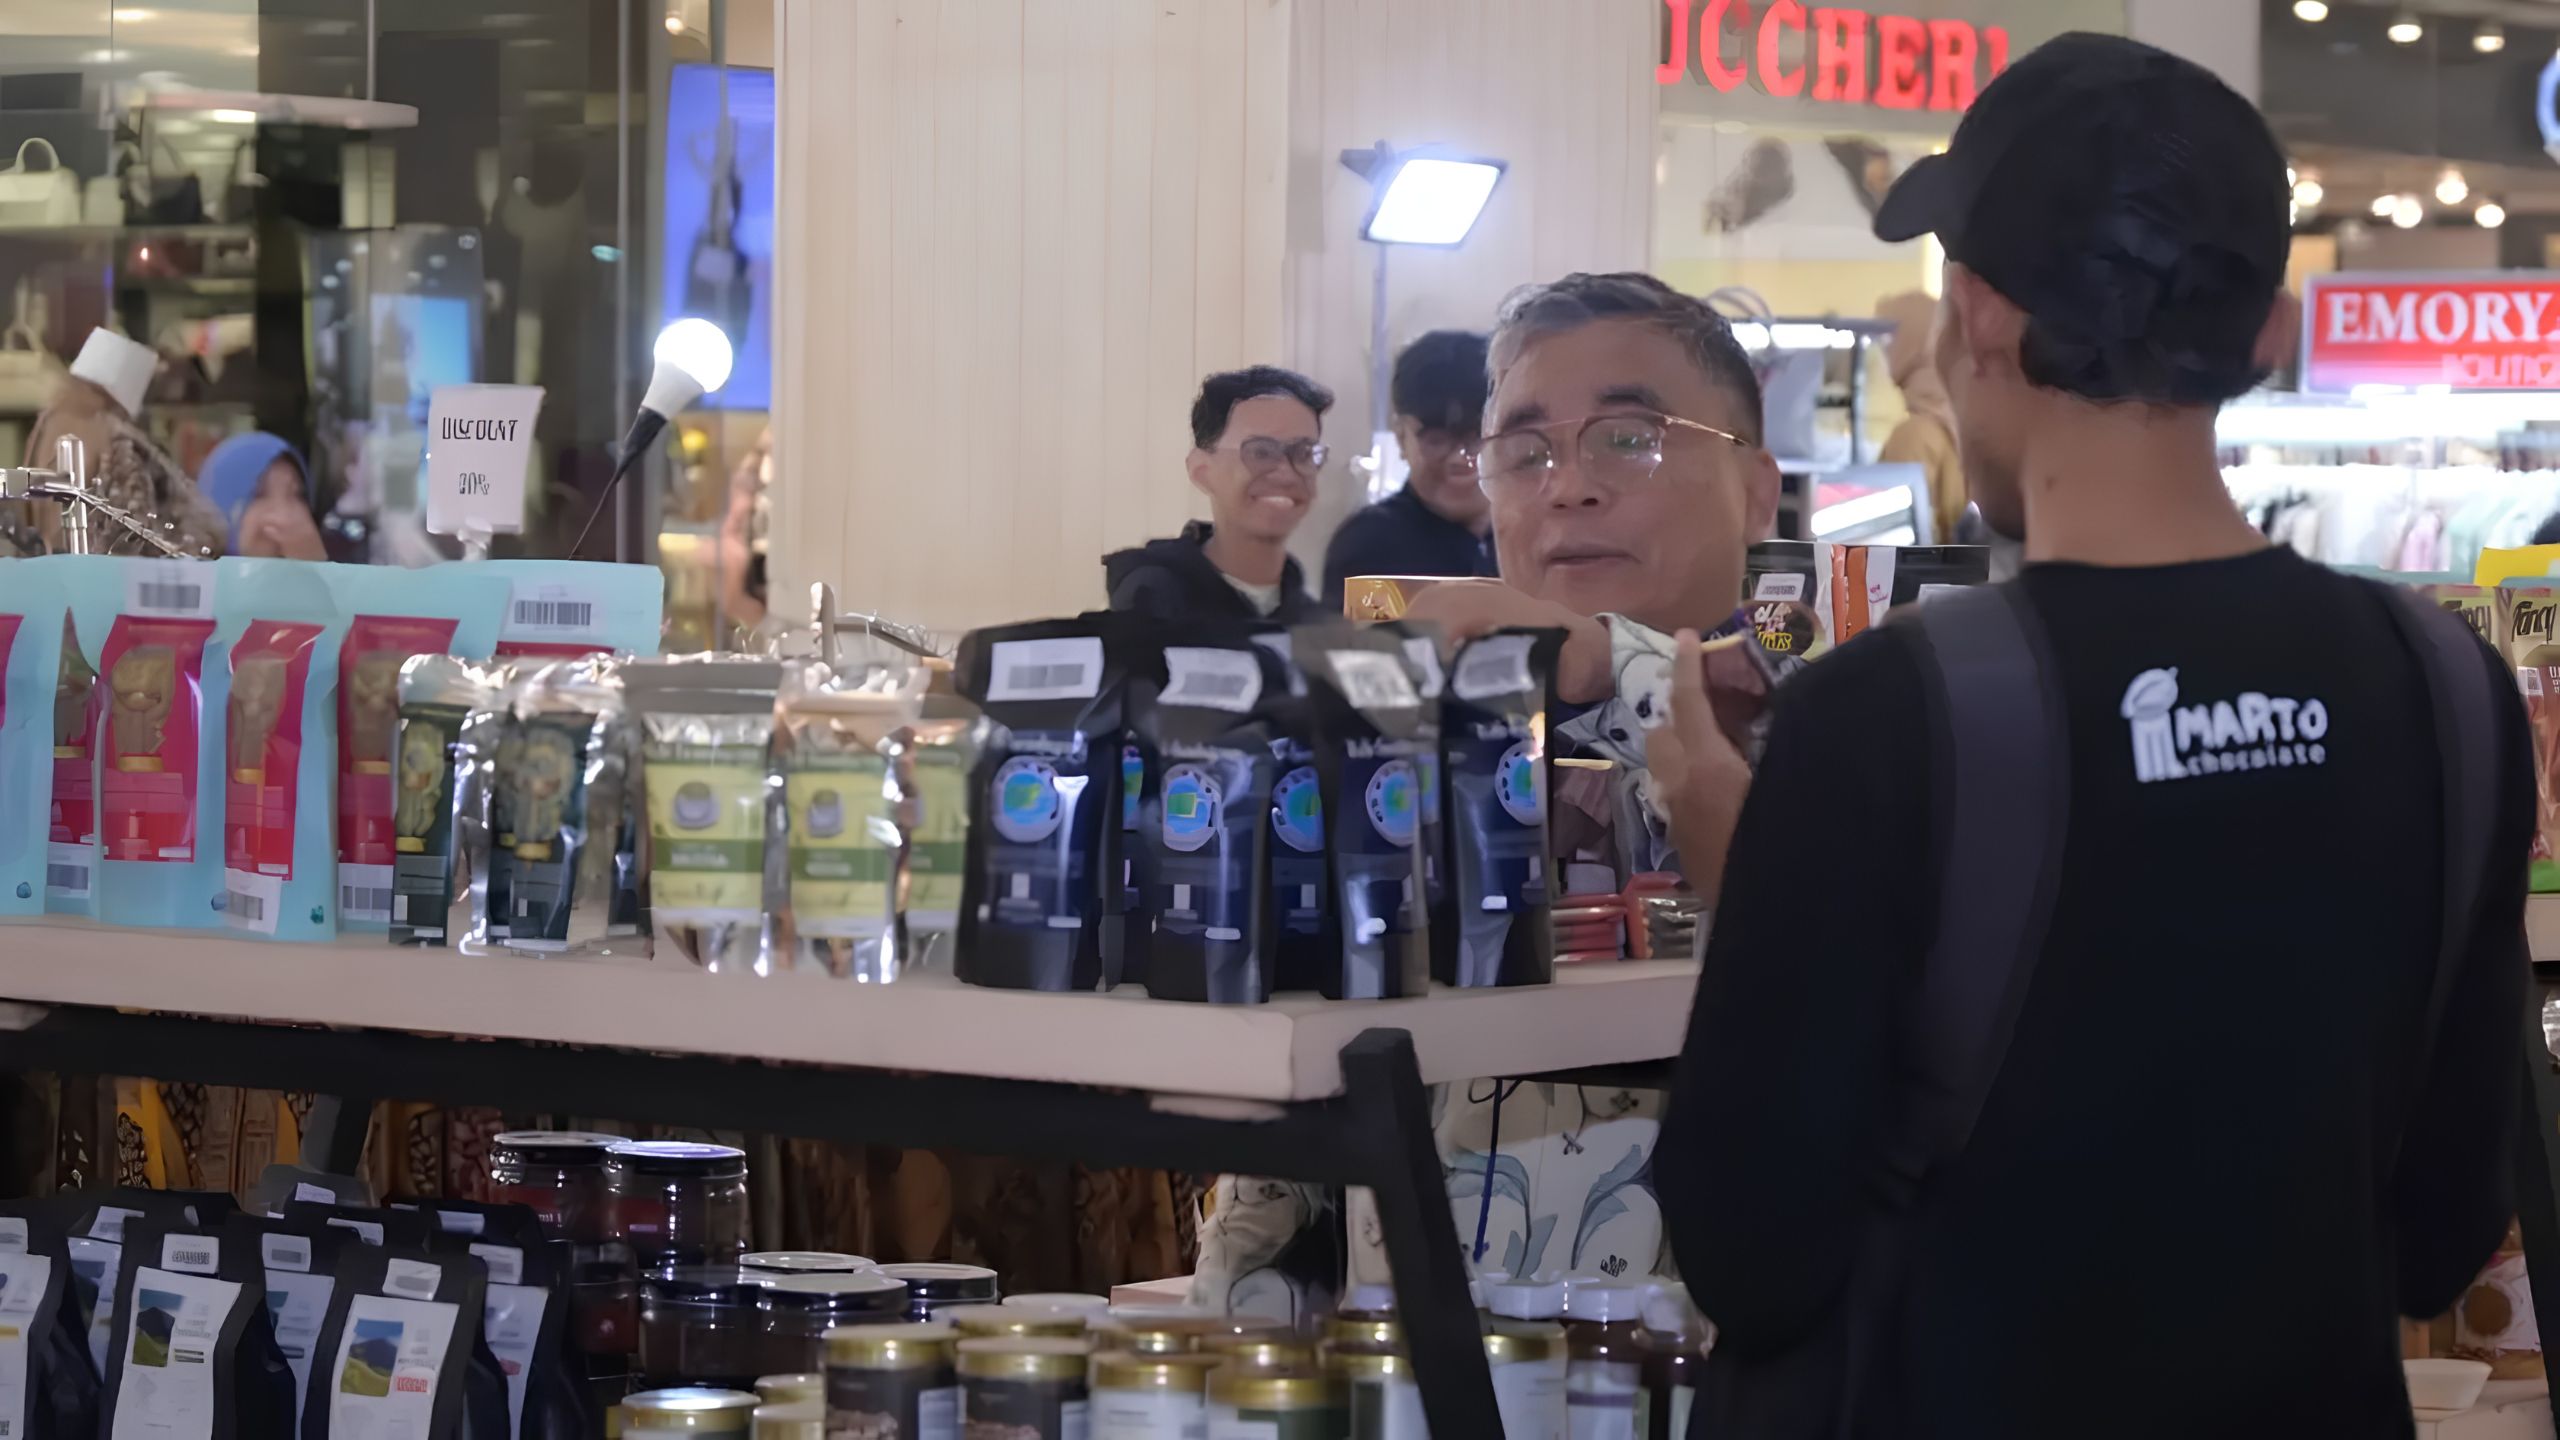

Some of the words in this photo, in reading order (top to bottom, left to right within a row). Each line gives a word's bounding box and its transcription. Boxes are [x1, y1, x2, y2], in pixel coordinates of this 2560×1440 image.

[2326, 291, 2554, 344] EMORY
[2175, 691, 2329, 752] MARTO
[2186, 743, 2326, 776] chocolate
